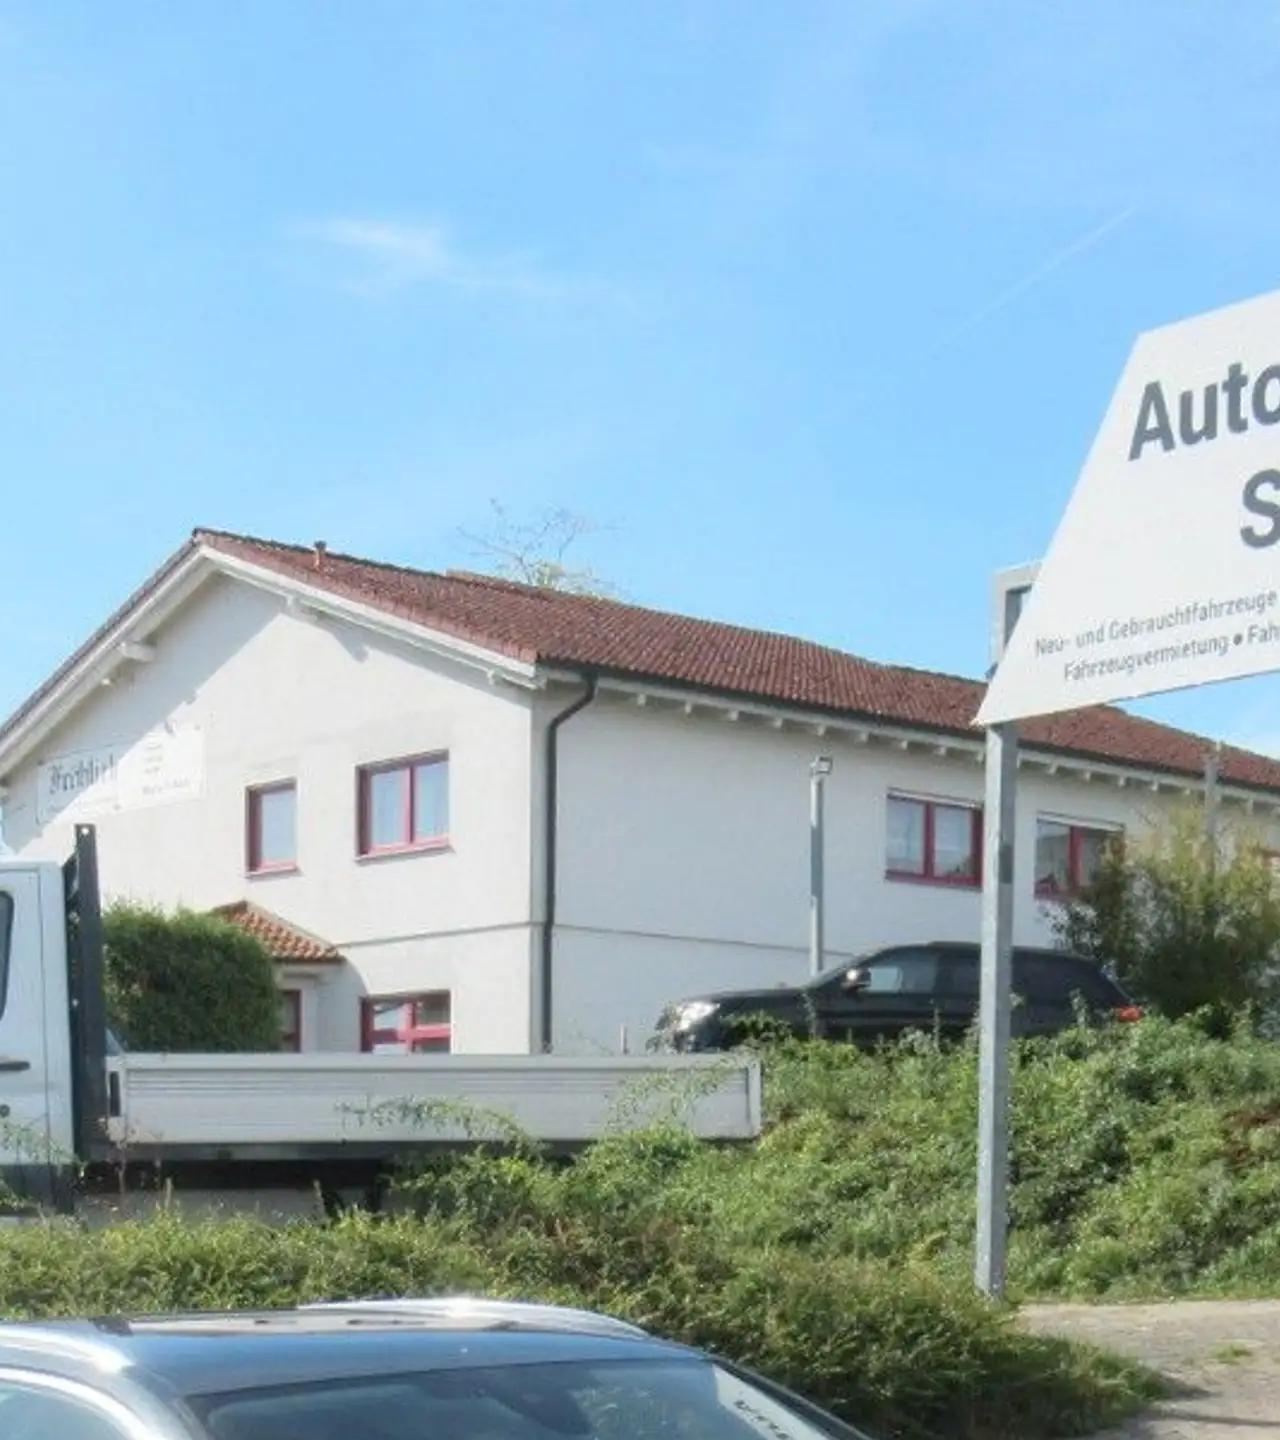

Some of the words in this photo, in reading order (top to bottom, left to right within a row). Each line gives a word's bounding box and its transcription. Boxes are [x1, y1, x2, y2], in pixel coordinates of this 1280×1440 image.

[1034, 636, 1070, 657] Neu-
[1076, 624, 1105, 649] und
[1108, 587, 1278, 645] Gebrauchtfahrzeuge
[1063, 634, 1229, 682] Fahrzeugvermietung
